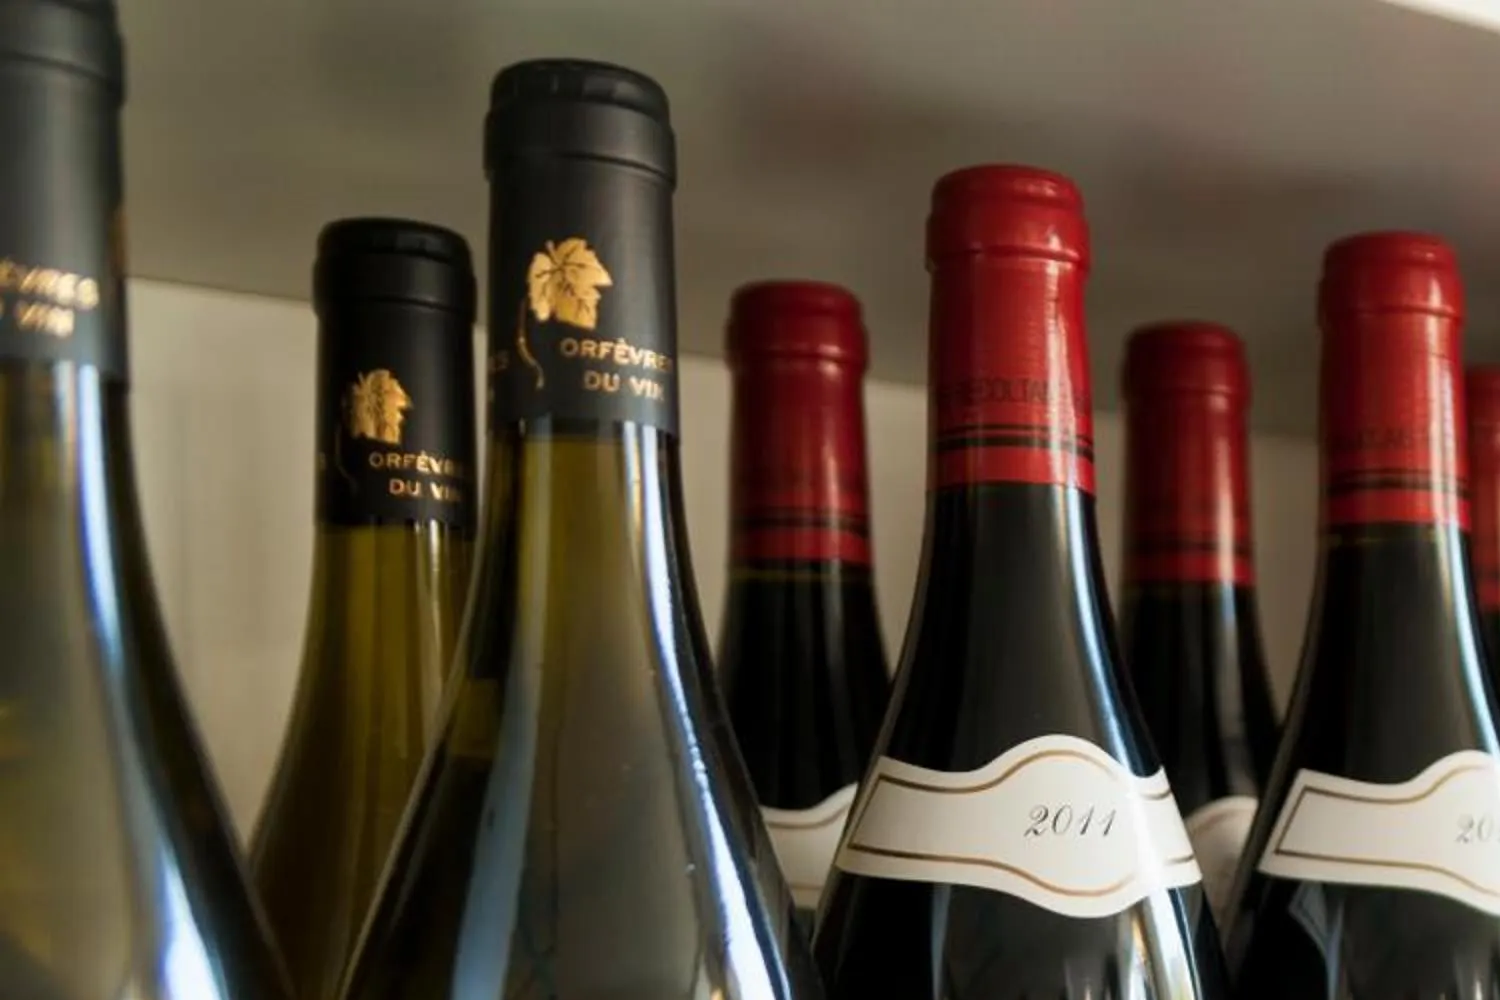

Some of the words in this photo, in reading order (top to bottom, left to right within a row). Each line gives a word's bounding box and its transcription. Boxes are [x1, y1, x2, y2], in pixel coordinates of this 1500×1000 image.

[560, 337, 672, 371] ORFÈVRE
[585, 370, 621, 393] DU
[389, 478, 421, 498] DU
[1024, 803, 1117, 838] 2011
